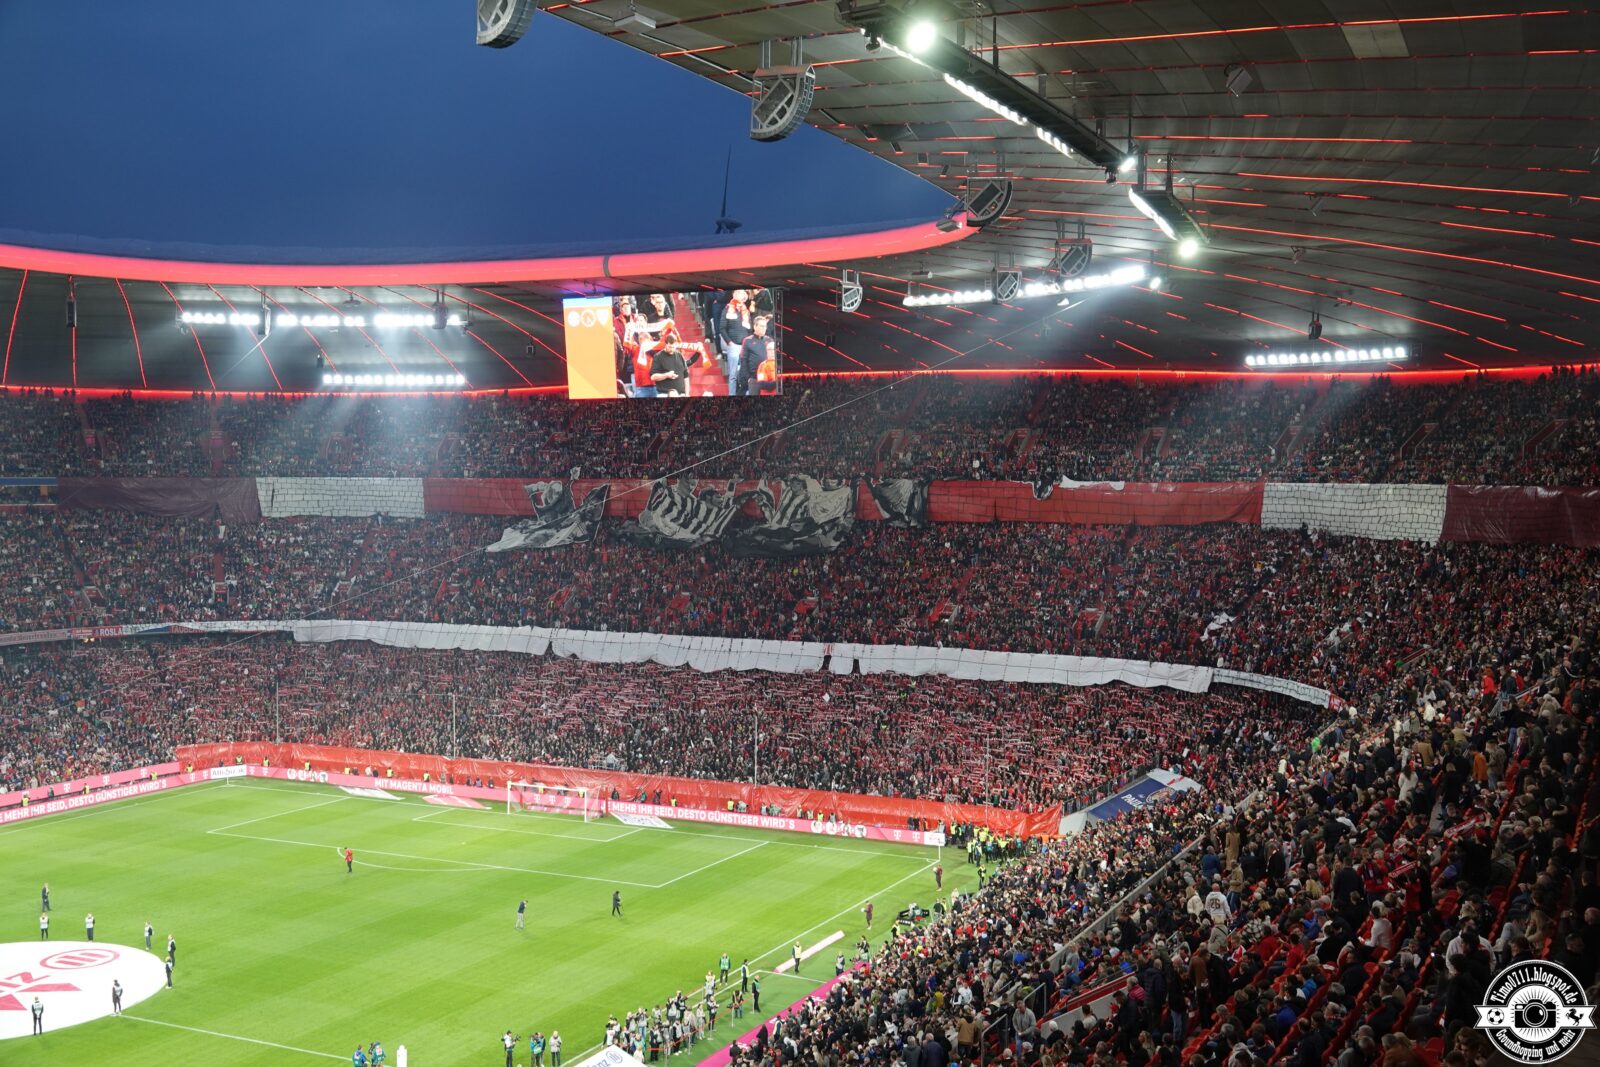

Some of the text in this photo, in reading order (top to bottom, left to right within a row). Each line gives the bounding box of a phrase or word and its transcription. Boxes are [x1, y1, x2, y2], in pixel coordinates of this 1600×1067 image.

[375, 778, 454, 795] MIT MAGENTA MOBIL
[5, 807, 29, 821] MEHR
[47, 799, 68, 813] SEID,
[69, 793, 95, 807] DESTO
[96, 785, 138, 800] GÜNSTIGER
[612, 802, 637, 812] MEHR
[638, 804, 653, 816] IHR
[654, 806, 677, 819] SEID,
[677, 808, 706, 821] DESTO
[707, 811, 759, 826] GÜNSTIGER
